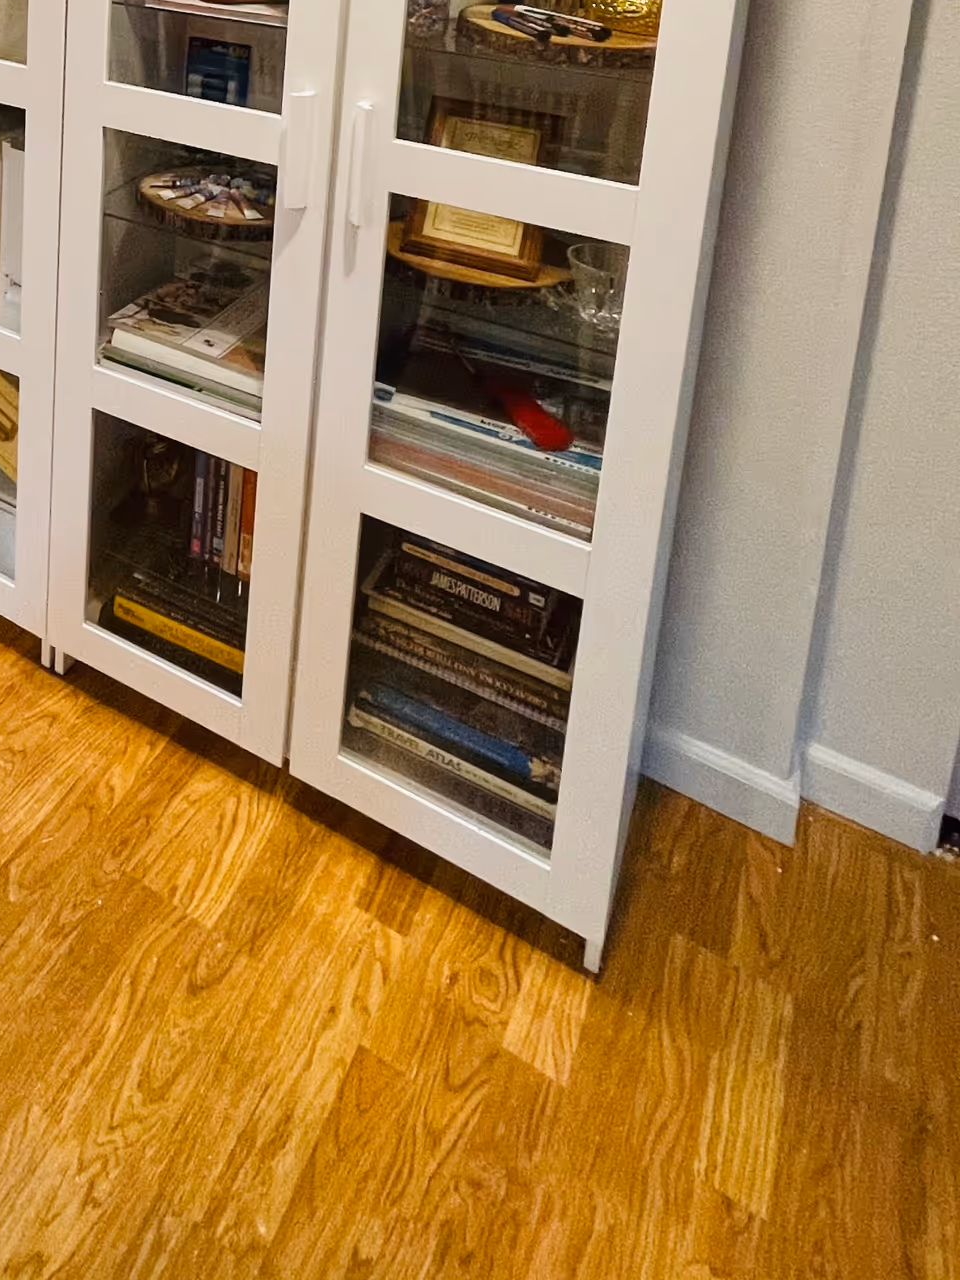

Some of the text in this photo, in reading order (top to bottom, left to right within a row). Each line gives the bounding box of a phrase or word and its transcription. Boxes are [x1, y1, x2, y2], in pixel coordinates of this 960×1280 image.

[430, 571, 456, 595] JAMES
[455, 581, 501, 612] PATTERSON
[380, 723, 464, 771] TRAVEL ATLAS
